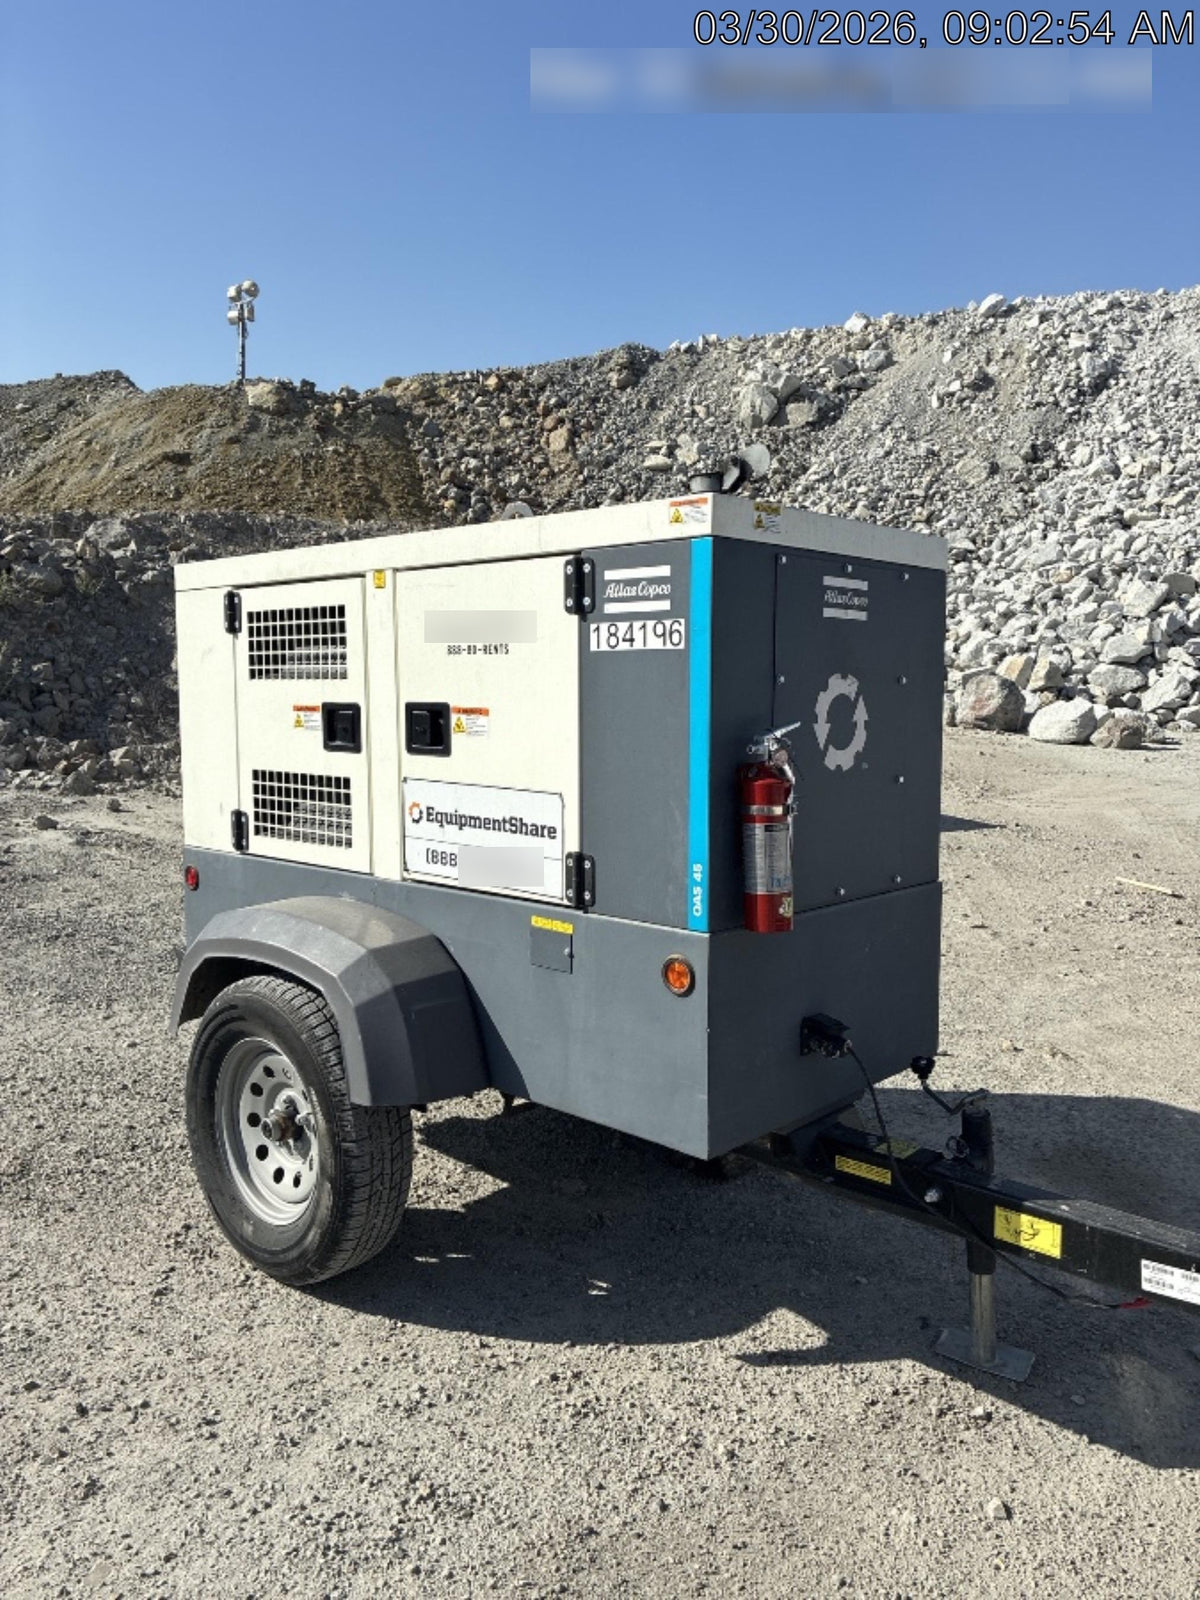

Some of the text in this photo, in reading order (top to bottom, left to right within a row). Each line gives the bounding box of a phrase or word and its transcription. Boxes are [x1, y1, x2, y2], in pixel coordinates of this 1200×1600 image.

[604, 581, 671, 598] Atlas Copco
[592, 620, 683, 649] 184196
[426, 806, 557, 839] EquipmentShare
